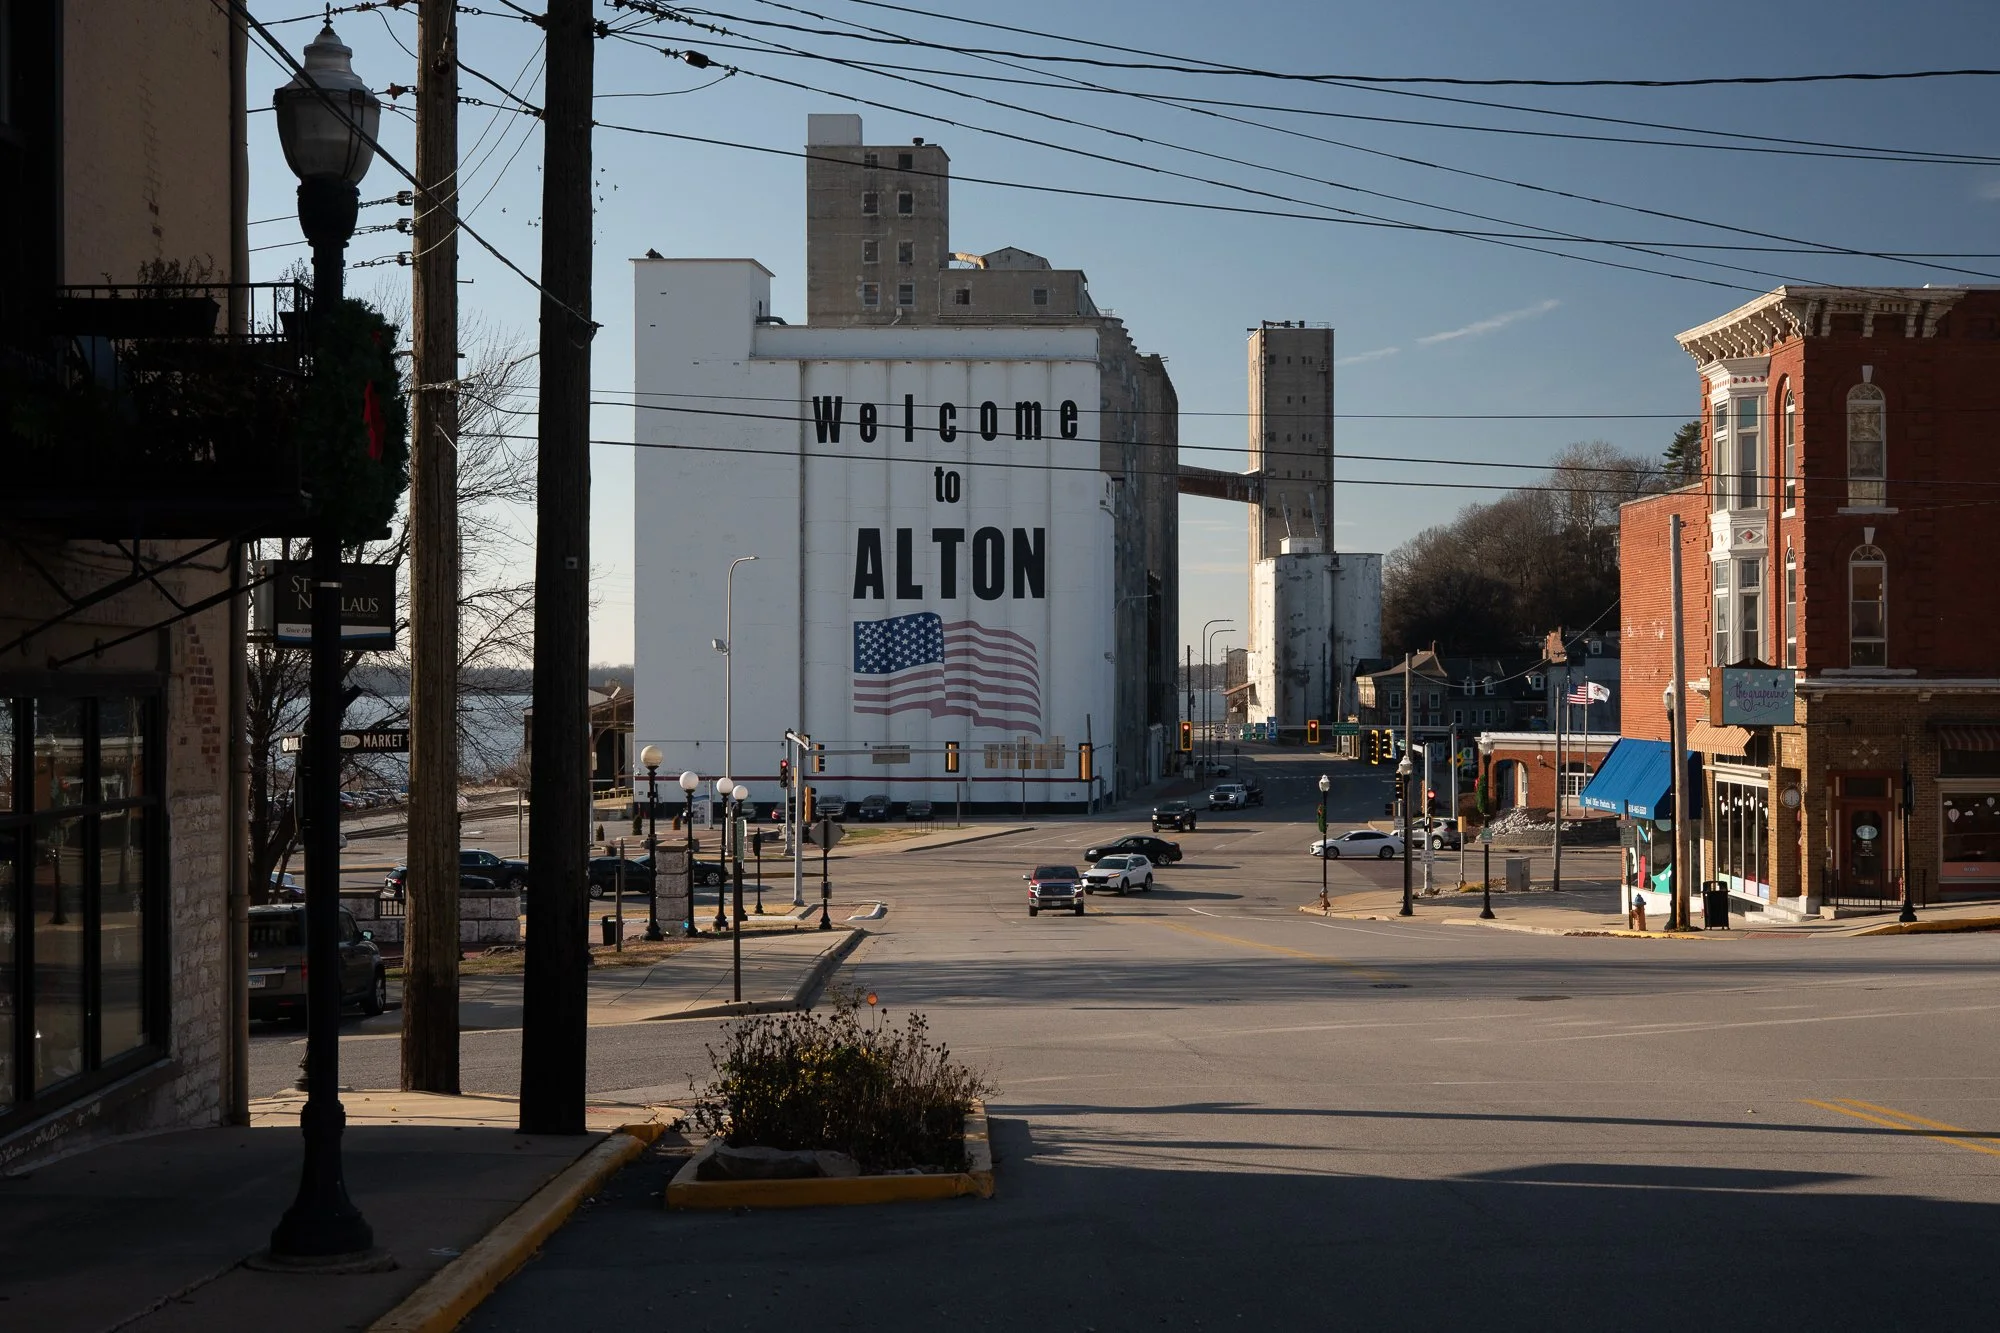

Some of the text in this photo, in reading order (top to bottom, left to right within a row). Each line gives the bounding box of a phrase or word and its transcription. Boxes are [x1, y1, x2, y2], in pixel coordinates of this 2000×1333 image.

[813, 394, 1078, 443] Welcome
[934, 466, 961, 503] to
[853, 526, 1045, 600] ALTON
[363, 734, 403, 748] MARKET
